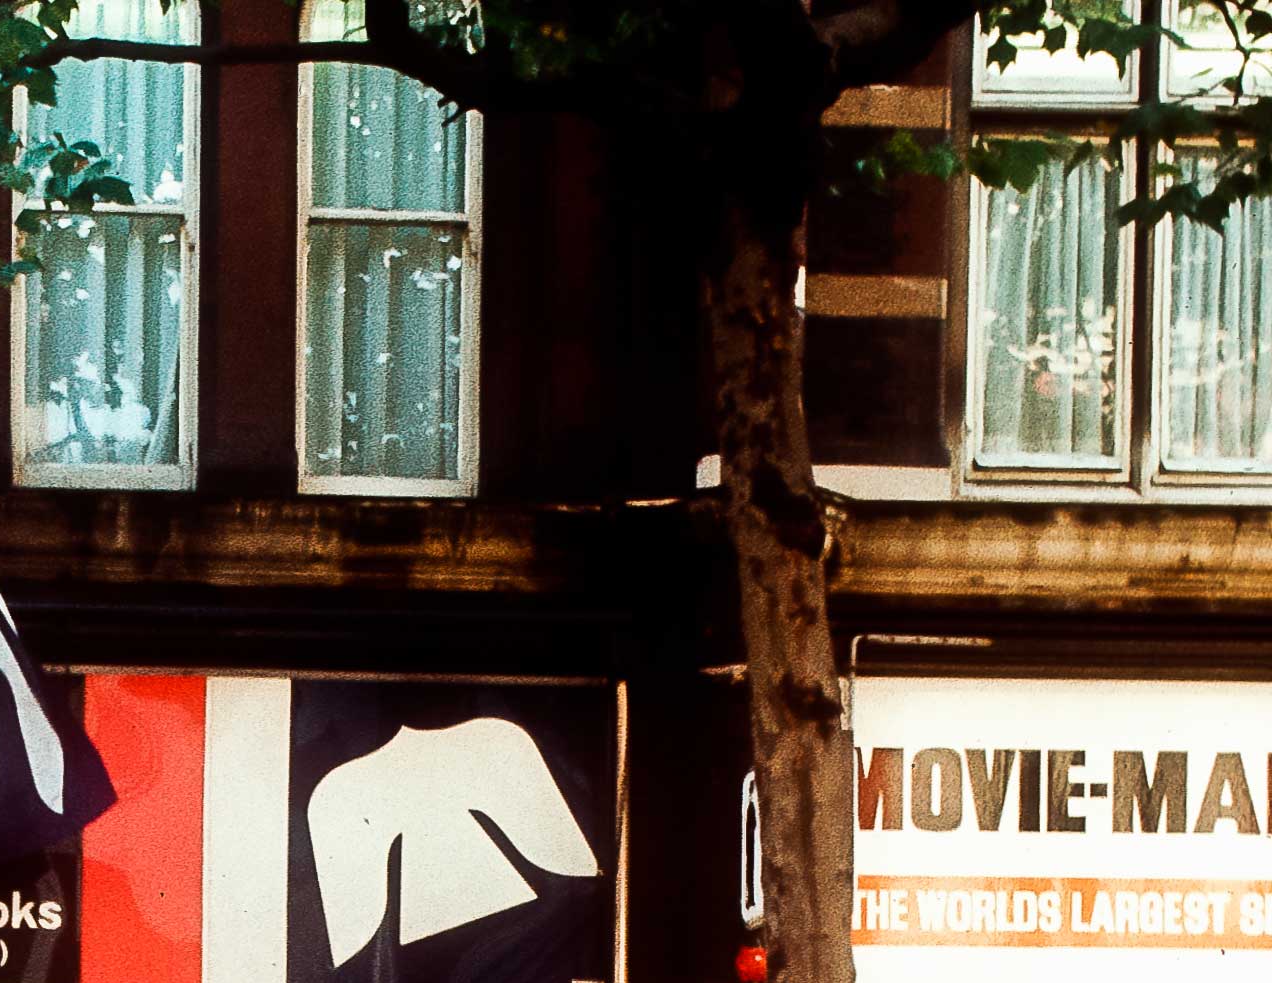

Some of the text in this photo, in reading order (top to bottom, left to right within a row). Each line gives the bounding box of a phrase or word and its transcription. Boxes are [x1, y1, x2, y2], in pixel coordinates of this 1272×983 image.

[855, 746, 1272, 835] MOVIE-MA
[916, 890, 1062, 933] WORLDS
[1071, 890, 1231, 935] LARGEST
[1239, 891, 1272, 937] S
